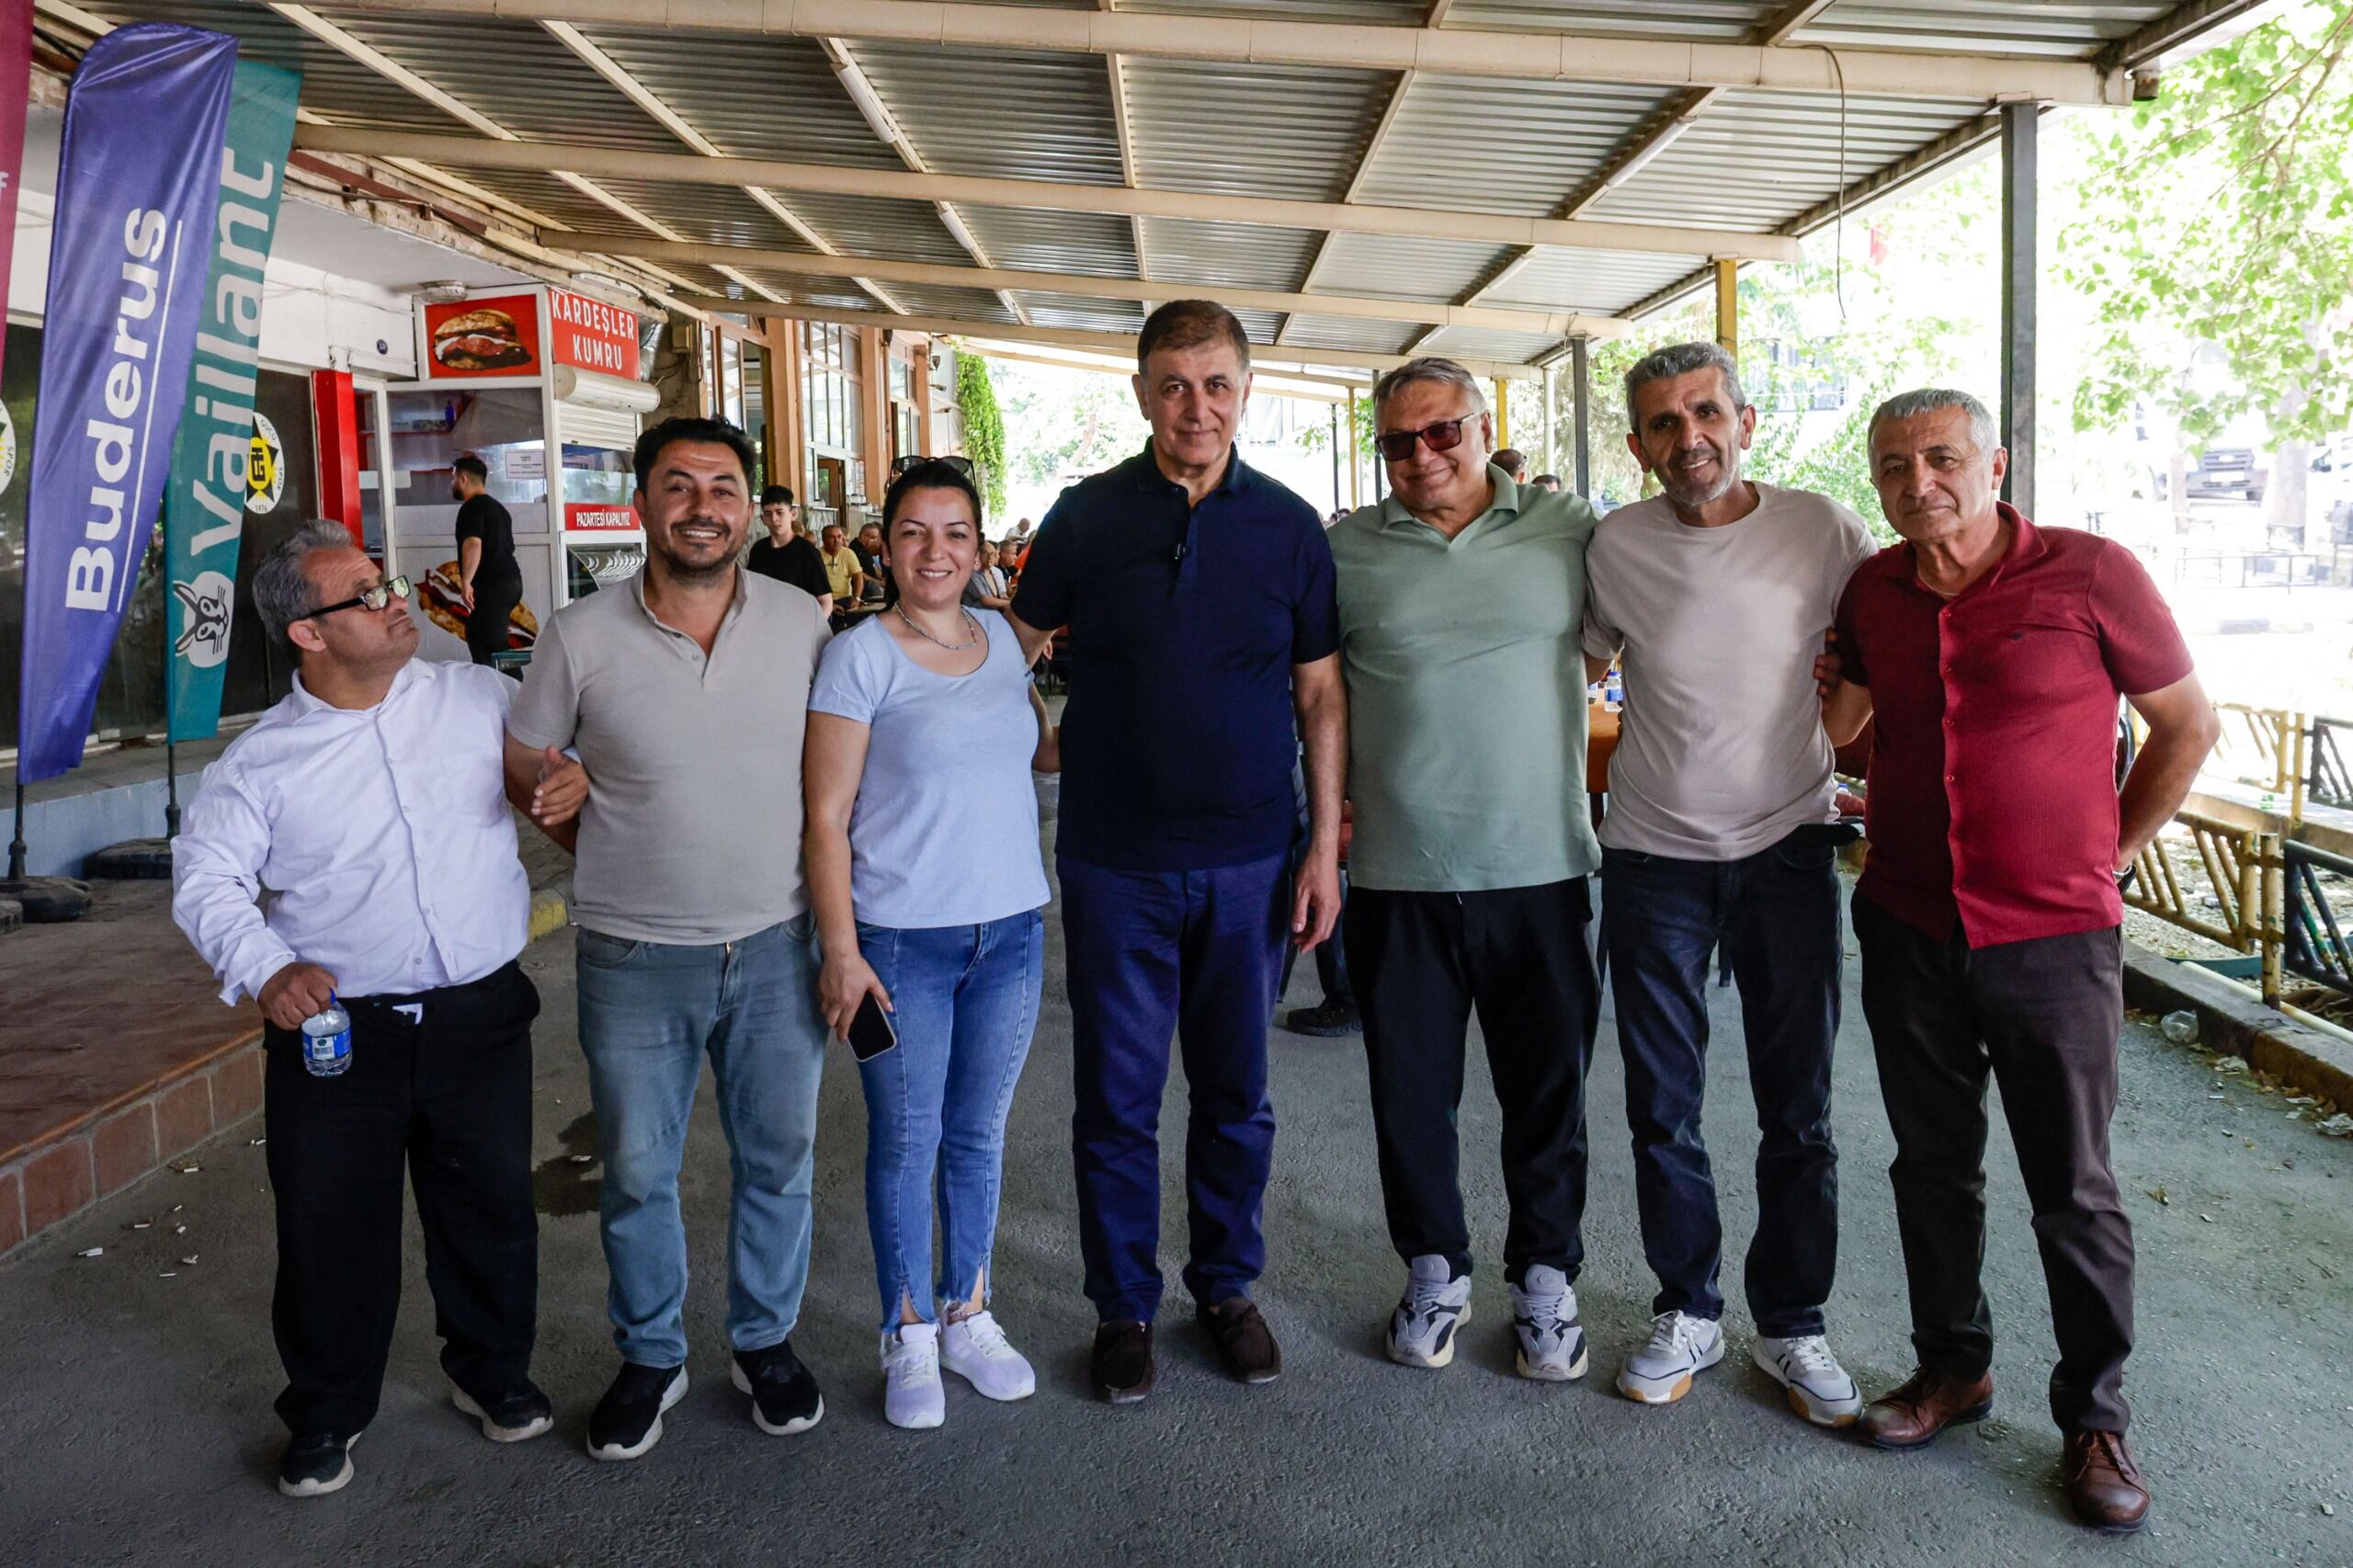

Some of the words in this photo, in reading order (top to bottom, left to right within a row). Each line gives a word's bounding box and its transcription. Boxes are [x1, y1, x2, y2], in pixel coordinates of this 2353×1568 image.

[551, 290, 634, 340] KARDEŞLER
[191, 147, 274, 556] Vaillant
[573, 334, 622, 371] KUMRU
[66, 208, 166, 610] Buderus
[576, 508, 605, 528] PAZARTESİ
